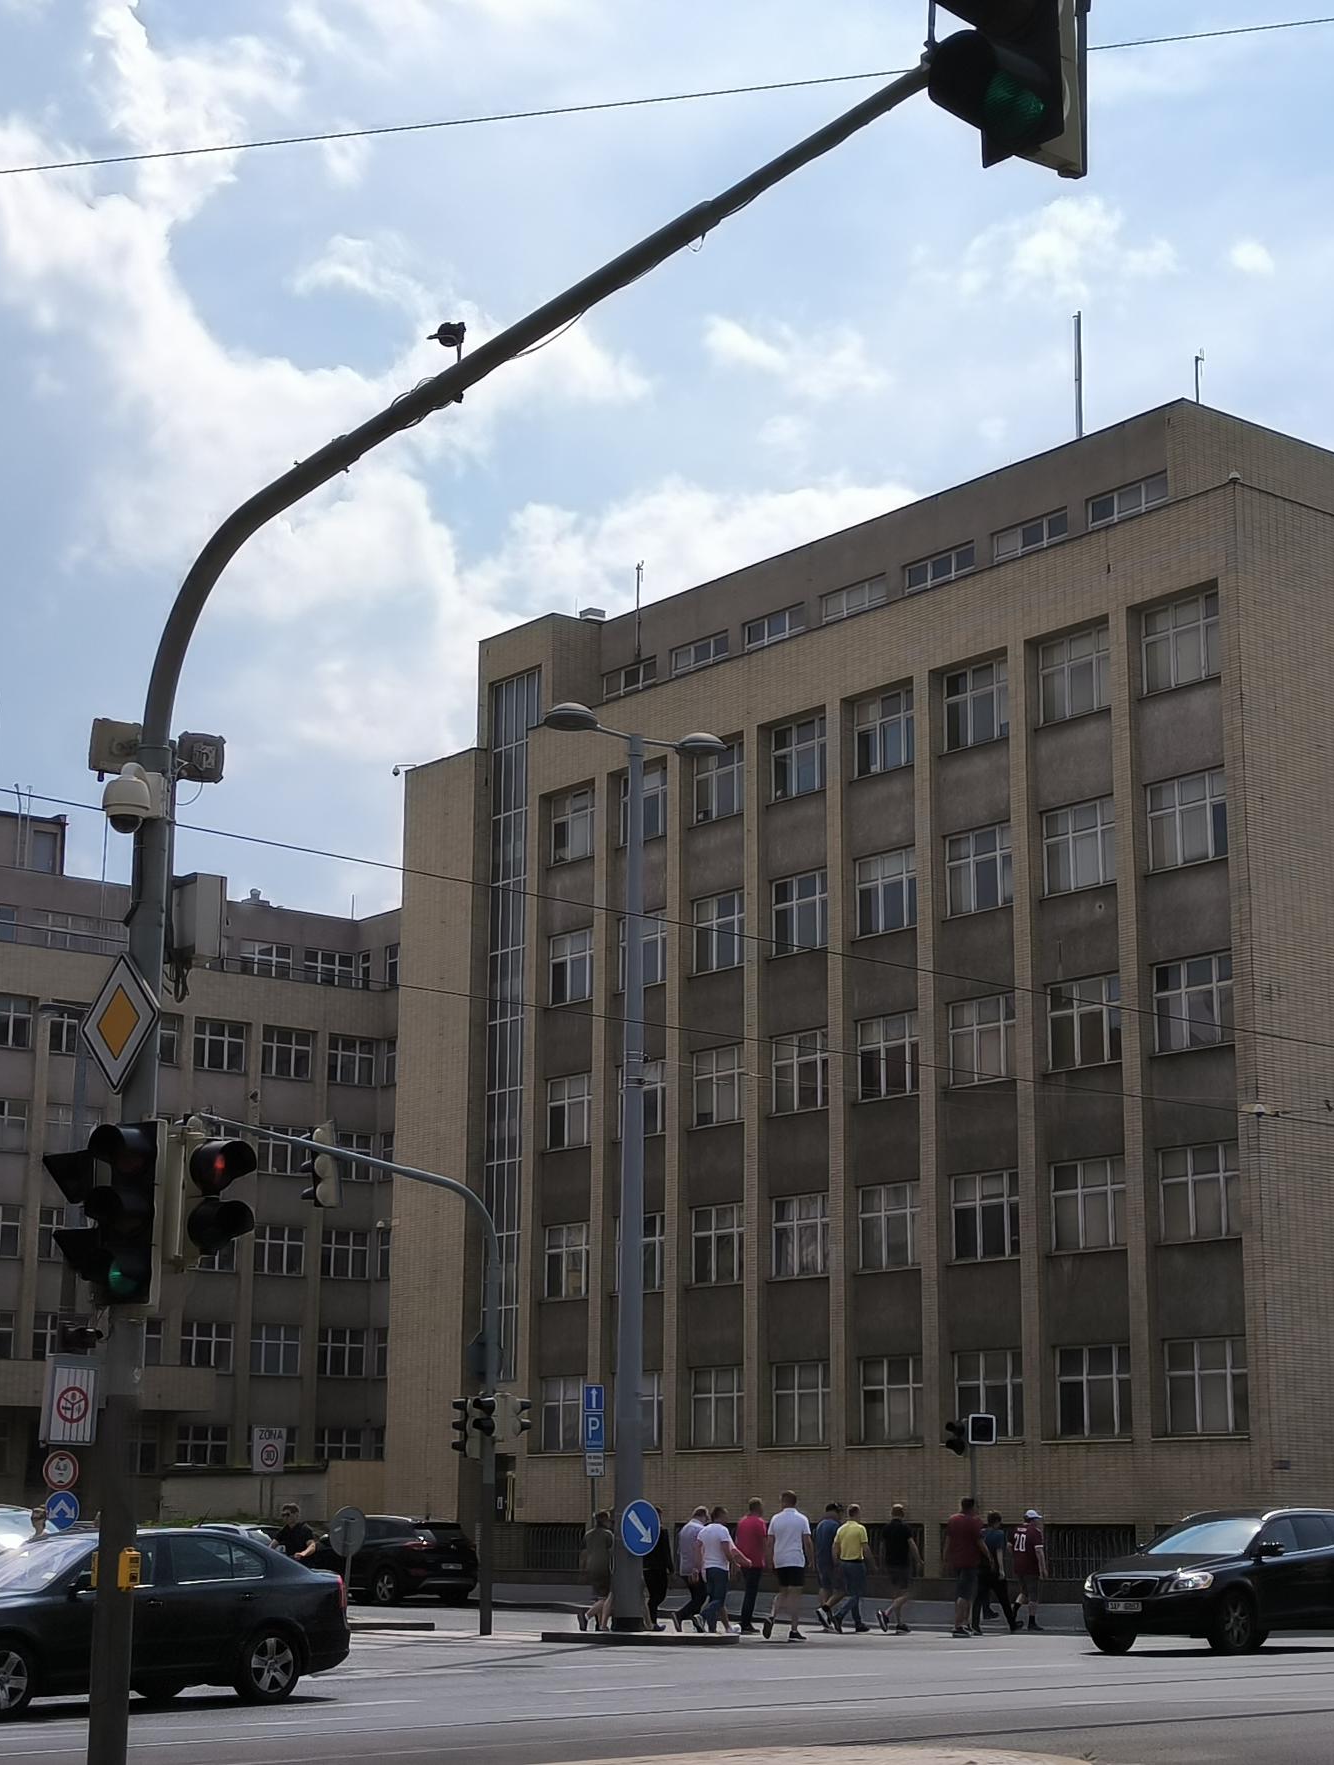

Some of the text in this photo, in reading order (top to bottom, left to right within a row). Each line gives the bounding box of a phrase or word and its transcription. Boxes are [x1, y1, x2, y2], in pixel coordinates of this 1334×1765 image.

[259, 1430, 283, 1440] ZONA
[588, 1417, 600, 1439] P
[264, 1450, 275, 1462] 30
[1014, 1533, 1027, 1552] 20
